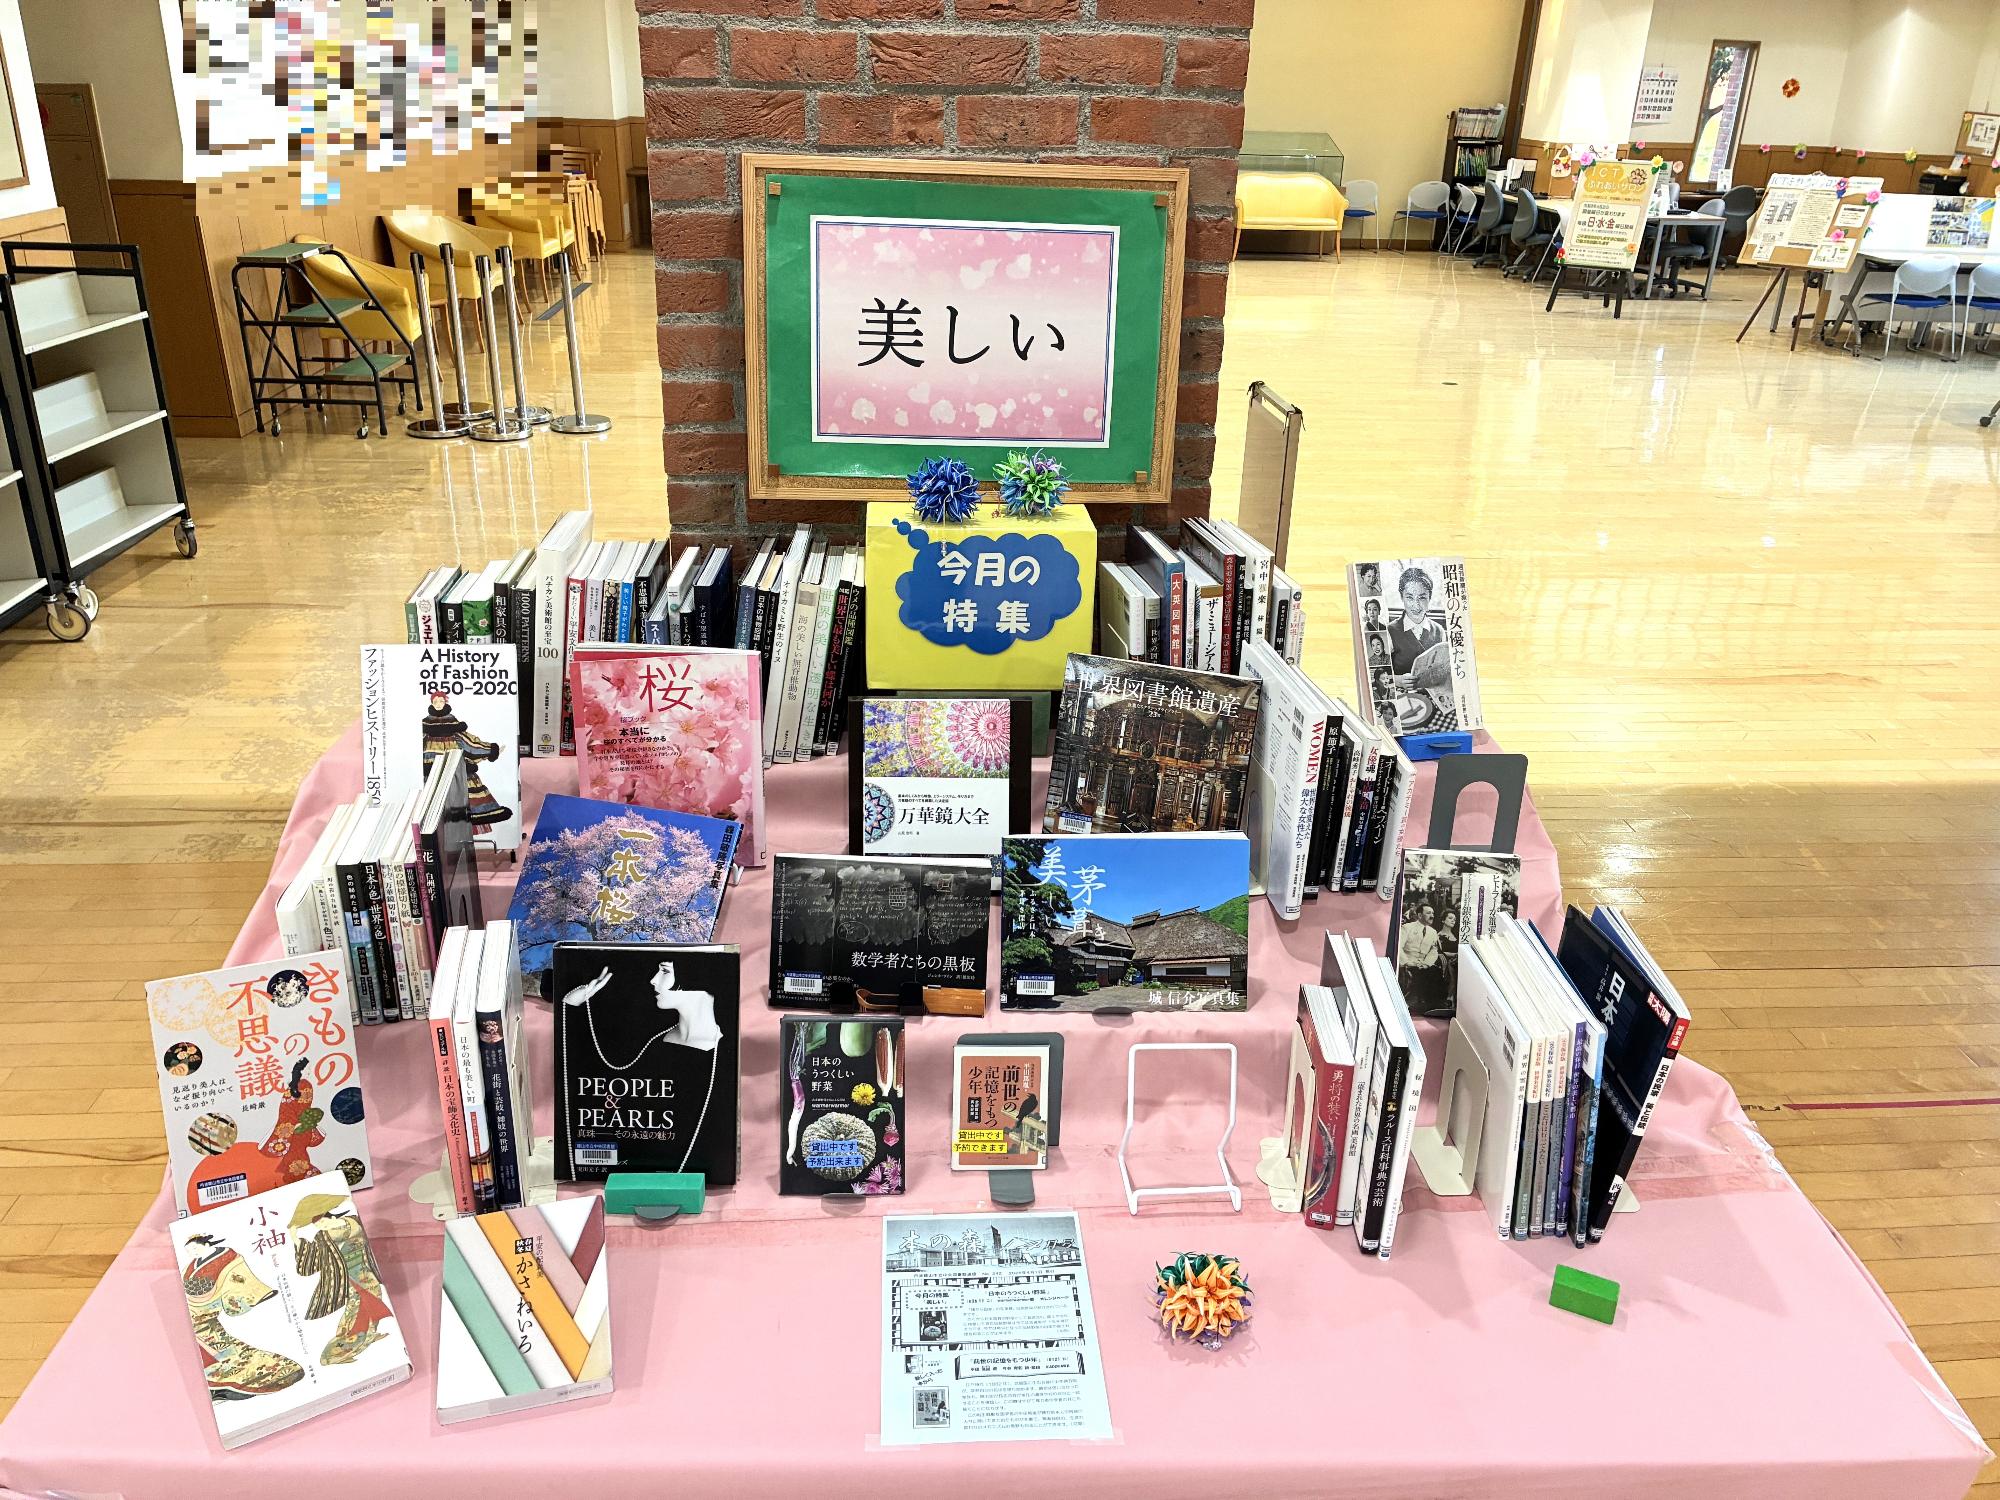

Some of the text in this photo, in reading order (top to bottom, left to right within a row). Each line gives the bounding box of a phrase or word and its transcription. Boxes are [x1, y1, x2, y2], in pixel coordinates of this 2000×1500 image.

[1588, 181, 1643, 192] ふれあいサロン
[1592, 168, 1620, 178] ICT
[1587, 217, 1615, 230] 日・水・金
[858, 297, 1065, 368] 美しい
[937, 551, 1041, 587] 今月の
[544, 575, 553, 646] バチカン美術館の至宝
[774, 581, 791, 663] オオカミと野生のイヌ
[943, 599, 1031, 634] 特集
[1171, 579, 1182, 651] 大英図書館
[1442, 564, 1467, 680] 昭和の女優たち
[520, 616, 530, 663] PATTERNS
[820, 595, 849, 707] 世界で最も美しい蝶は何か
[1204, 597, 1219, 672] ザ・ミュージアム
[420, 647, 500, 667] A History
[537, 647, 559, 659] 100
[787, 616, 809, 702] 海の美しい無脊椎動物
[420, 664, 509, 680] of Fashion
[638, 663, 694, 713] 桜
[1078, 672, 1241, 719] 世界図書館遺産
[603, 735, 667, 746] 桜のすべてが分かる
[618, 727, 650, 737] 本当に
[1327, 726, 1339, 755] 原節子
[1305, 720, 1325, 784] WOMEN
[1365, 746, 1379, 774] 女優魂
[898, 806, 990, 825] 万華鏡大全
[1295, 788, 1311, 849] 偉大な女性たち
[1303, 788, 1317, 841] 世界を変えた
[591, 828, 655, 925] 一本桜
[345, 874, 362, 926] 色の秘めたる歴史
[364, 865, 387, 940] 日本の色・世界の色
[1067, 863, 1107, 942] 茅葺き
[851, 952, 976, 973] 数学者たちの黒板
[225, 975, 287, 1100] 不思議
[301, 962, 354, 1087] きもの
[283, 1033, 309, 1056] の
[811, 1057, 842, 1067] 日本の
[172, 1078, 227, 1094] 見返り美人は
[460, 1036, 476, 1105] 日本の最も美しい町
[577, 1077, 675, 1098] PEOPLE
[811, 1081, 834, 1092] 野菜
[812, 1068, 855, 1080] うつくしい
[967, 1065, 983, 1095] 少年
[173, 1085, 234, 1103] なぜ振り向いて
[174, 1098, 215, 1112] いるのか？
[443, 1075, 461, 1137] 日本の宝飾文化史
[604, 1094, 621, 1109] &
[984, 1065, 1000, 1128] 記憶をもつ
[1001, 1064, 1022, 1113] 前世の
[1325, 1070, 1345, 1120] 勇将の装い
[577, 1108, 674, 1129] PEARLS
[957, 1131, 1003, 1139] 貸出中です
[807, 1157, 863, 1167] 予約出来ます
[811, 1142, 858, 1152] 貸出中です
[953, 1143, 1006, 1152] 予約できます
[249, 1207, 286, 1256] 小袖
[898, 1228, 984, 1254] 本の森
[514, 1256, 534, 1354] かさねいろ
